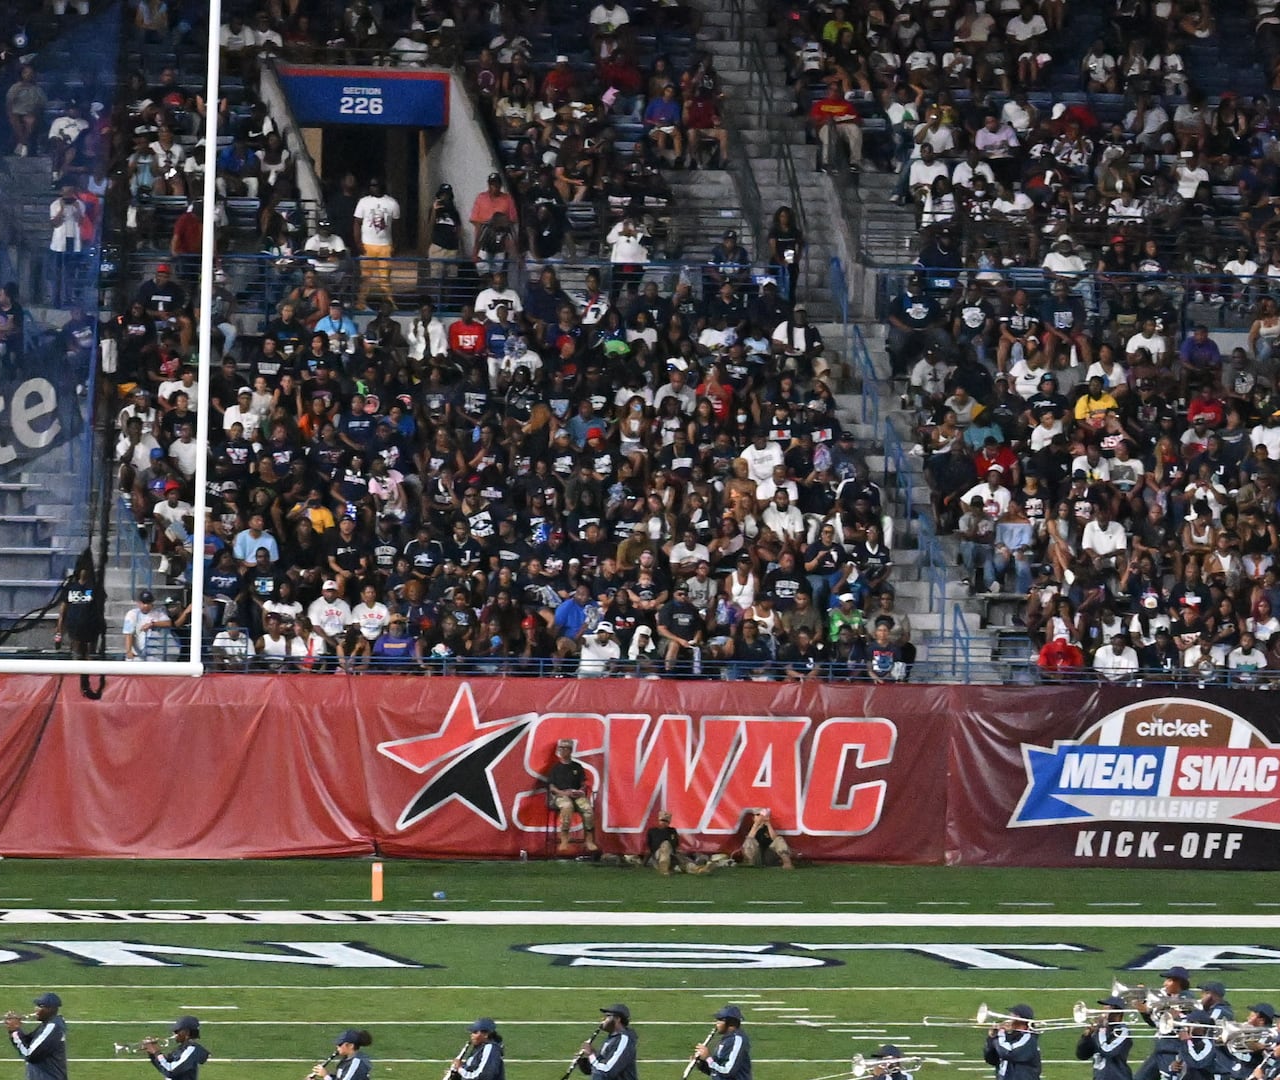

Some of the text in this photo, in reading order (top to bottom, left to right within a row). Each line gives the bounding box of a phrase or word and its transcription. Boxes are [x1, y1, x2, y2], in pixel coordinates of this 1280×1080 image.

[342, 87, 382, 95] SECTION
[340, 97, 384, 115] 226
[1136, 718, 1212, 738] cricket
[512, 712, 898, 836] SWAC
[1058, 753, 1280, 793] MEAC SWAC
[1108, 799, 1220, 819] CHALLENGE
[1074, 830, 1244, 860] KICK-OFF
